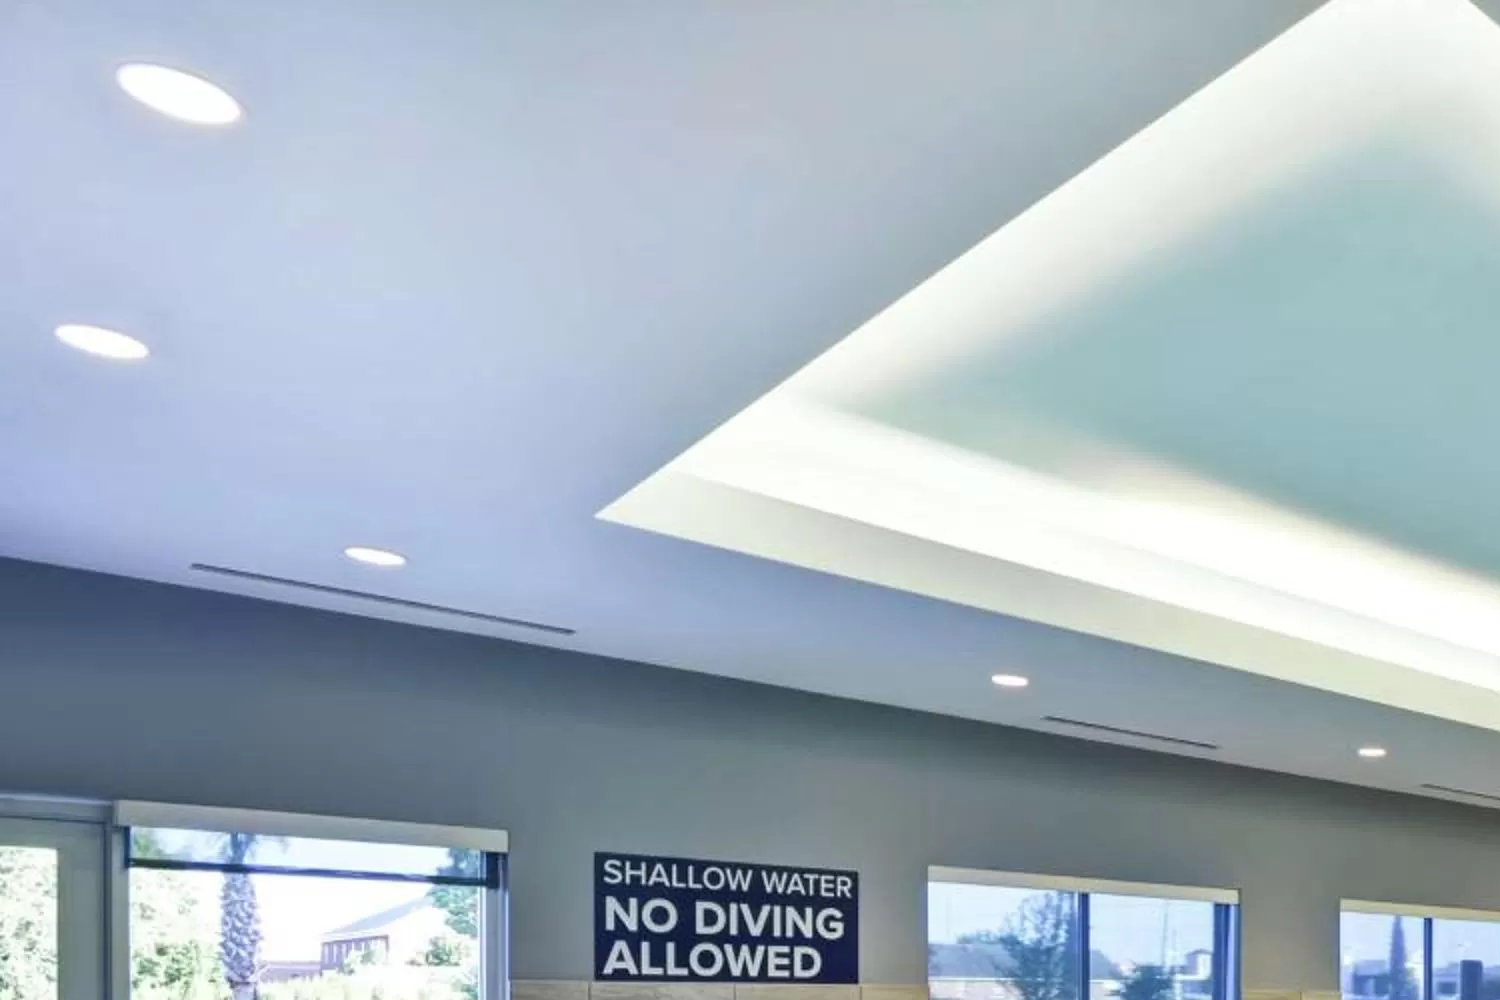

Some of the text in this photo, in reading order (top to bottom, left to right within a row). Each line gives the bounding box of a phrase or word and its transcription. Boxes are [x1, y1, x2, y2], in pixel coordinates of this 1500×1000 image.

[603, 859, 853, 898] SHALLOW WATER
[605, 896, 845, 940] NO DIVING
[603, 940, 822, 978] ALLOWED
